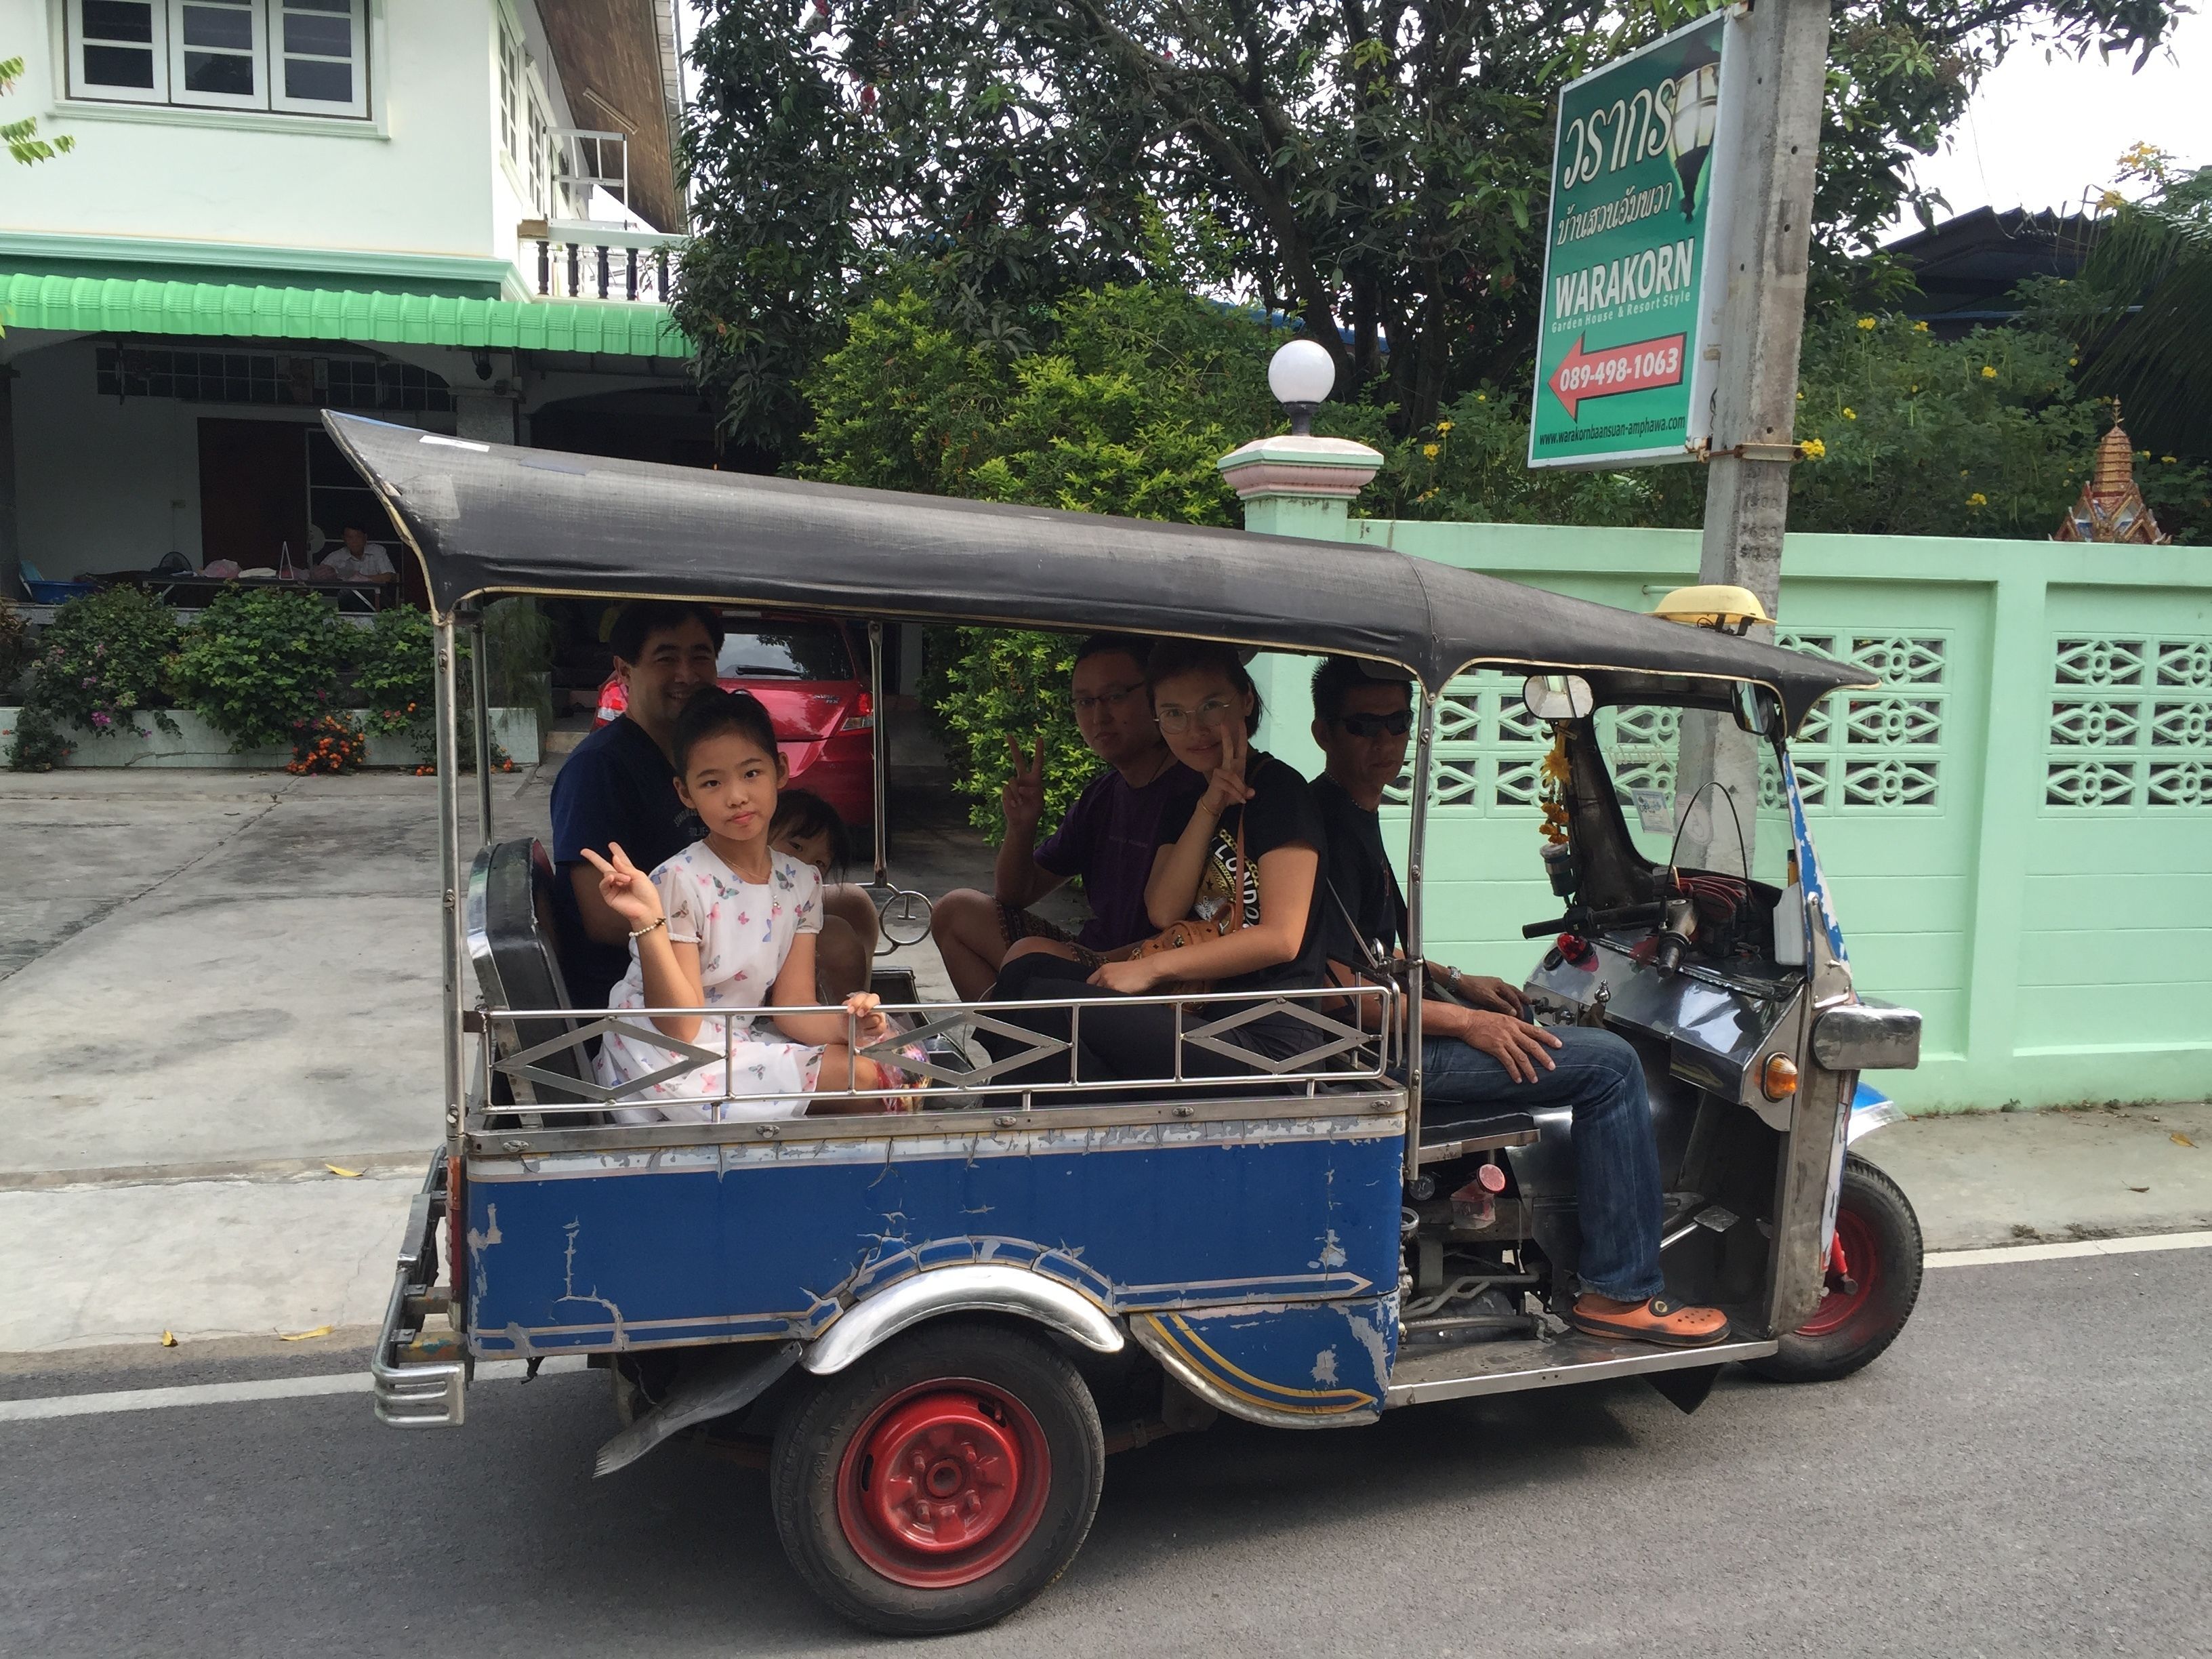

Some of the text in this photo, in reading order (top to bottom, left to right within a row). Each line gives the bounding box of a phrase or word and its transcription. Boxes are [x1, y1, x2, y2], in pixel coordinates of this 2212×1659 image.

[1563, 77, 1677, 190] วรากร
[1557, 182, 1673, 246] บ้านสวนอัมพวา
[1555, 237, 1695, 320] WARAKORN
[1551, 290, 1691, 333] Garden House & Resort Style
[1559, 347, 1679, 392] 089-498-1063
[1539, 415, 1686, 445] www.warakornbaansuan-amphawa.com
[1214, 844, 1259, 926] LONDO
